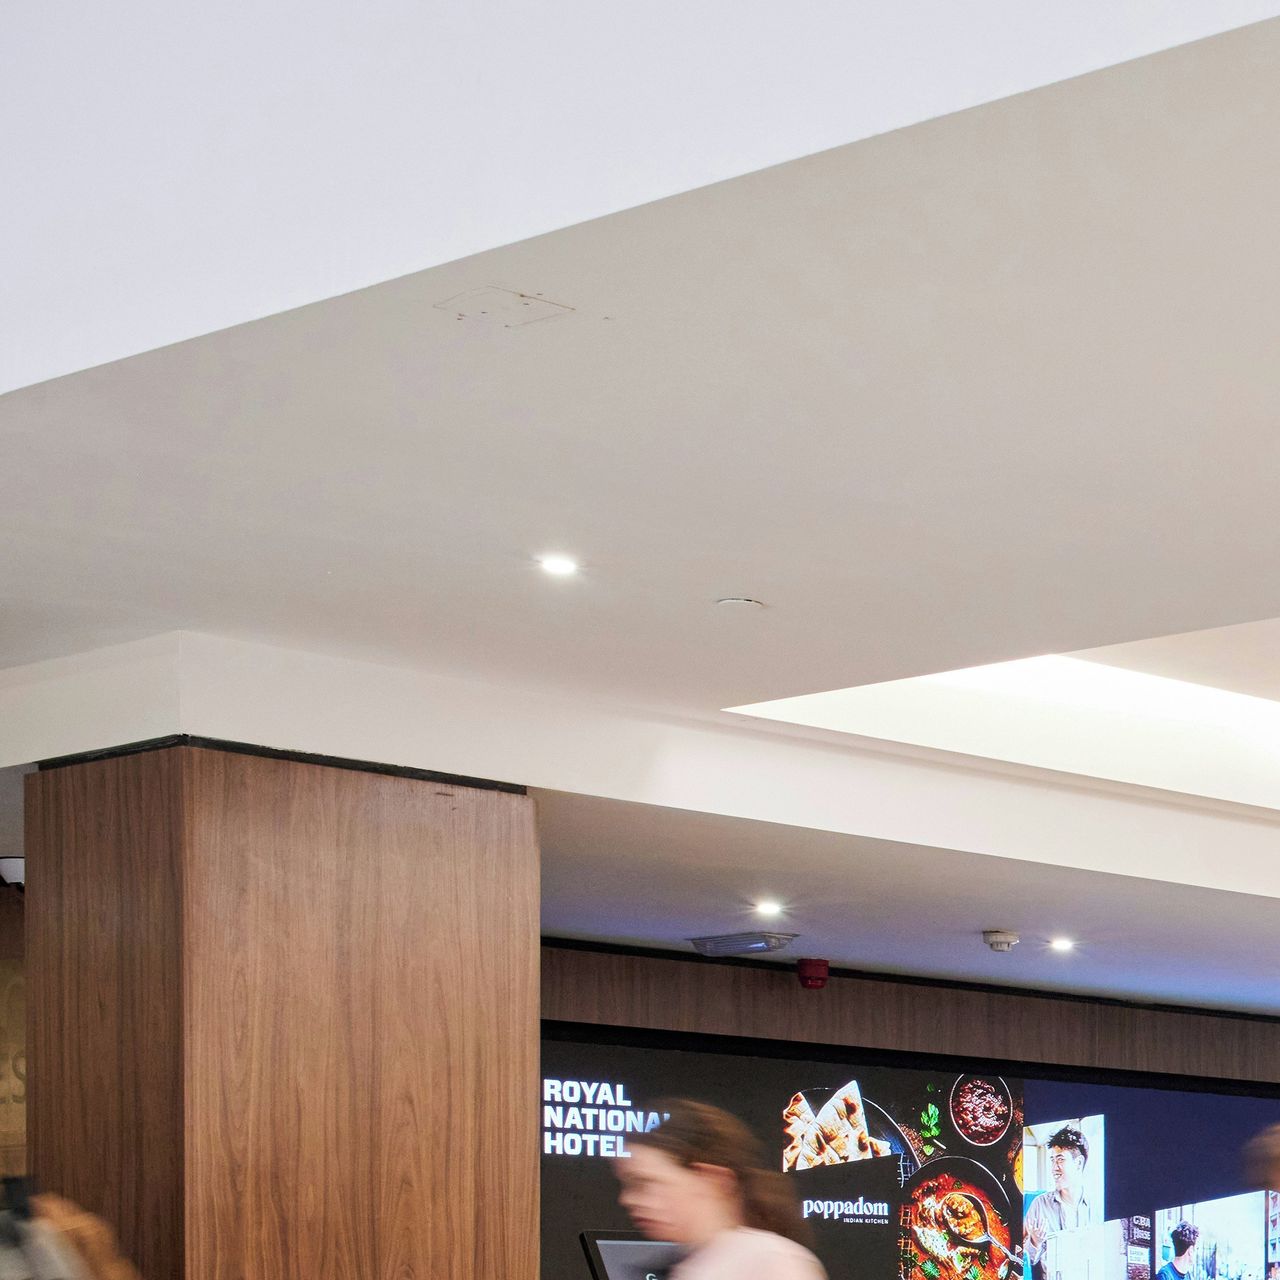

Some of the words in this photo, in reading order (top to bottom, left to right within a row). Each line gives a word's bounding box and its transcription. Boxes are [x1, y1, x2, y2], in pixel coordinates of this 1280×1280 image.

[543, 1078, 632, 1107] ROYAL
[543, 1105, 671, 1133] NATIONA
[543, 1131, 632, 1158] HOTEL
[802, 1196, 889, 1220] poppadom
